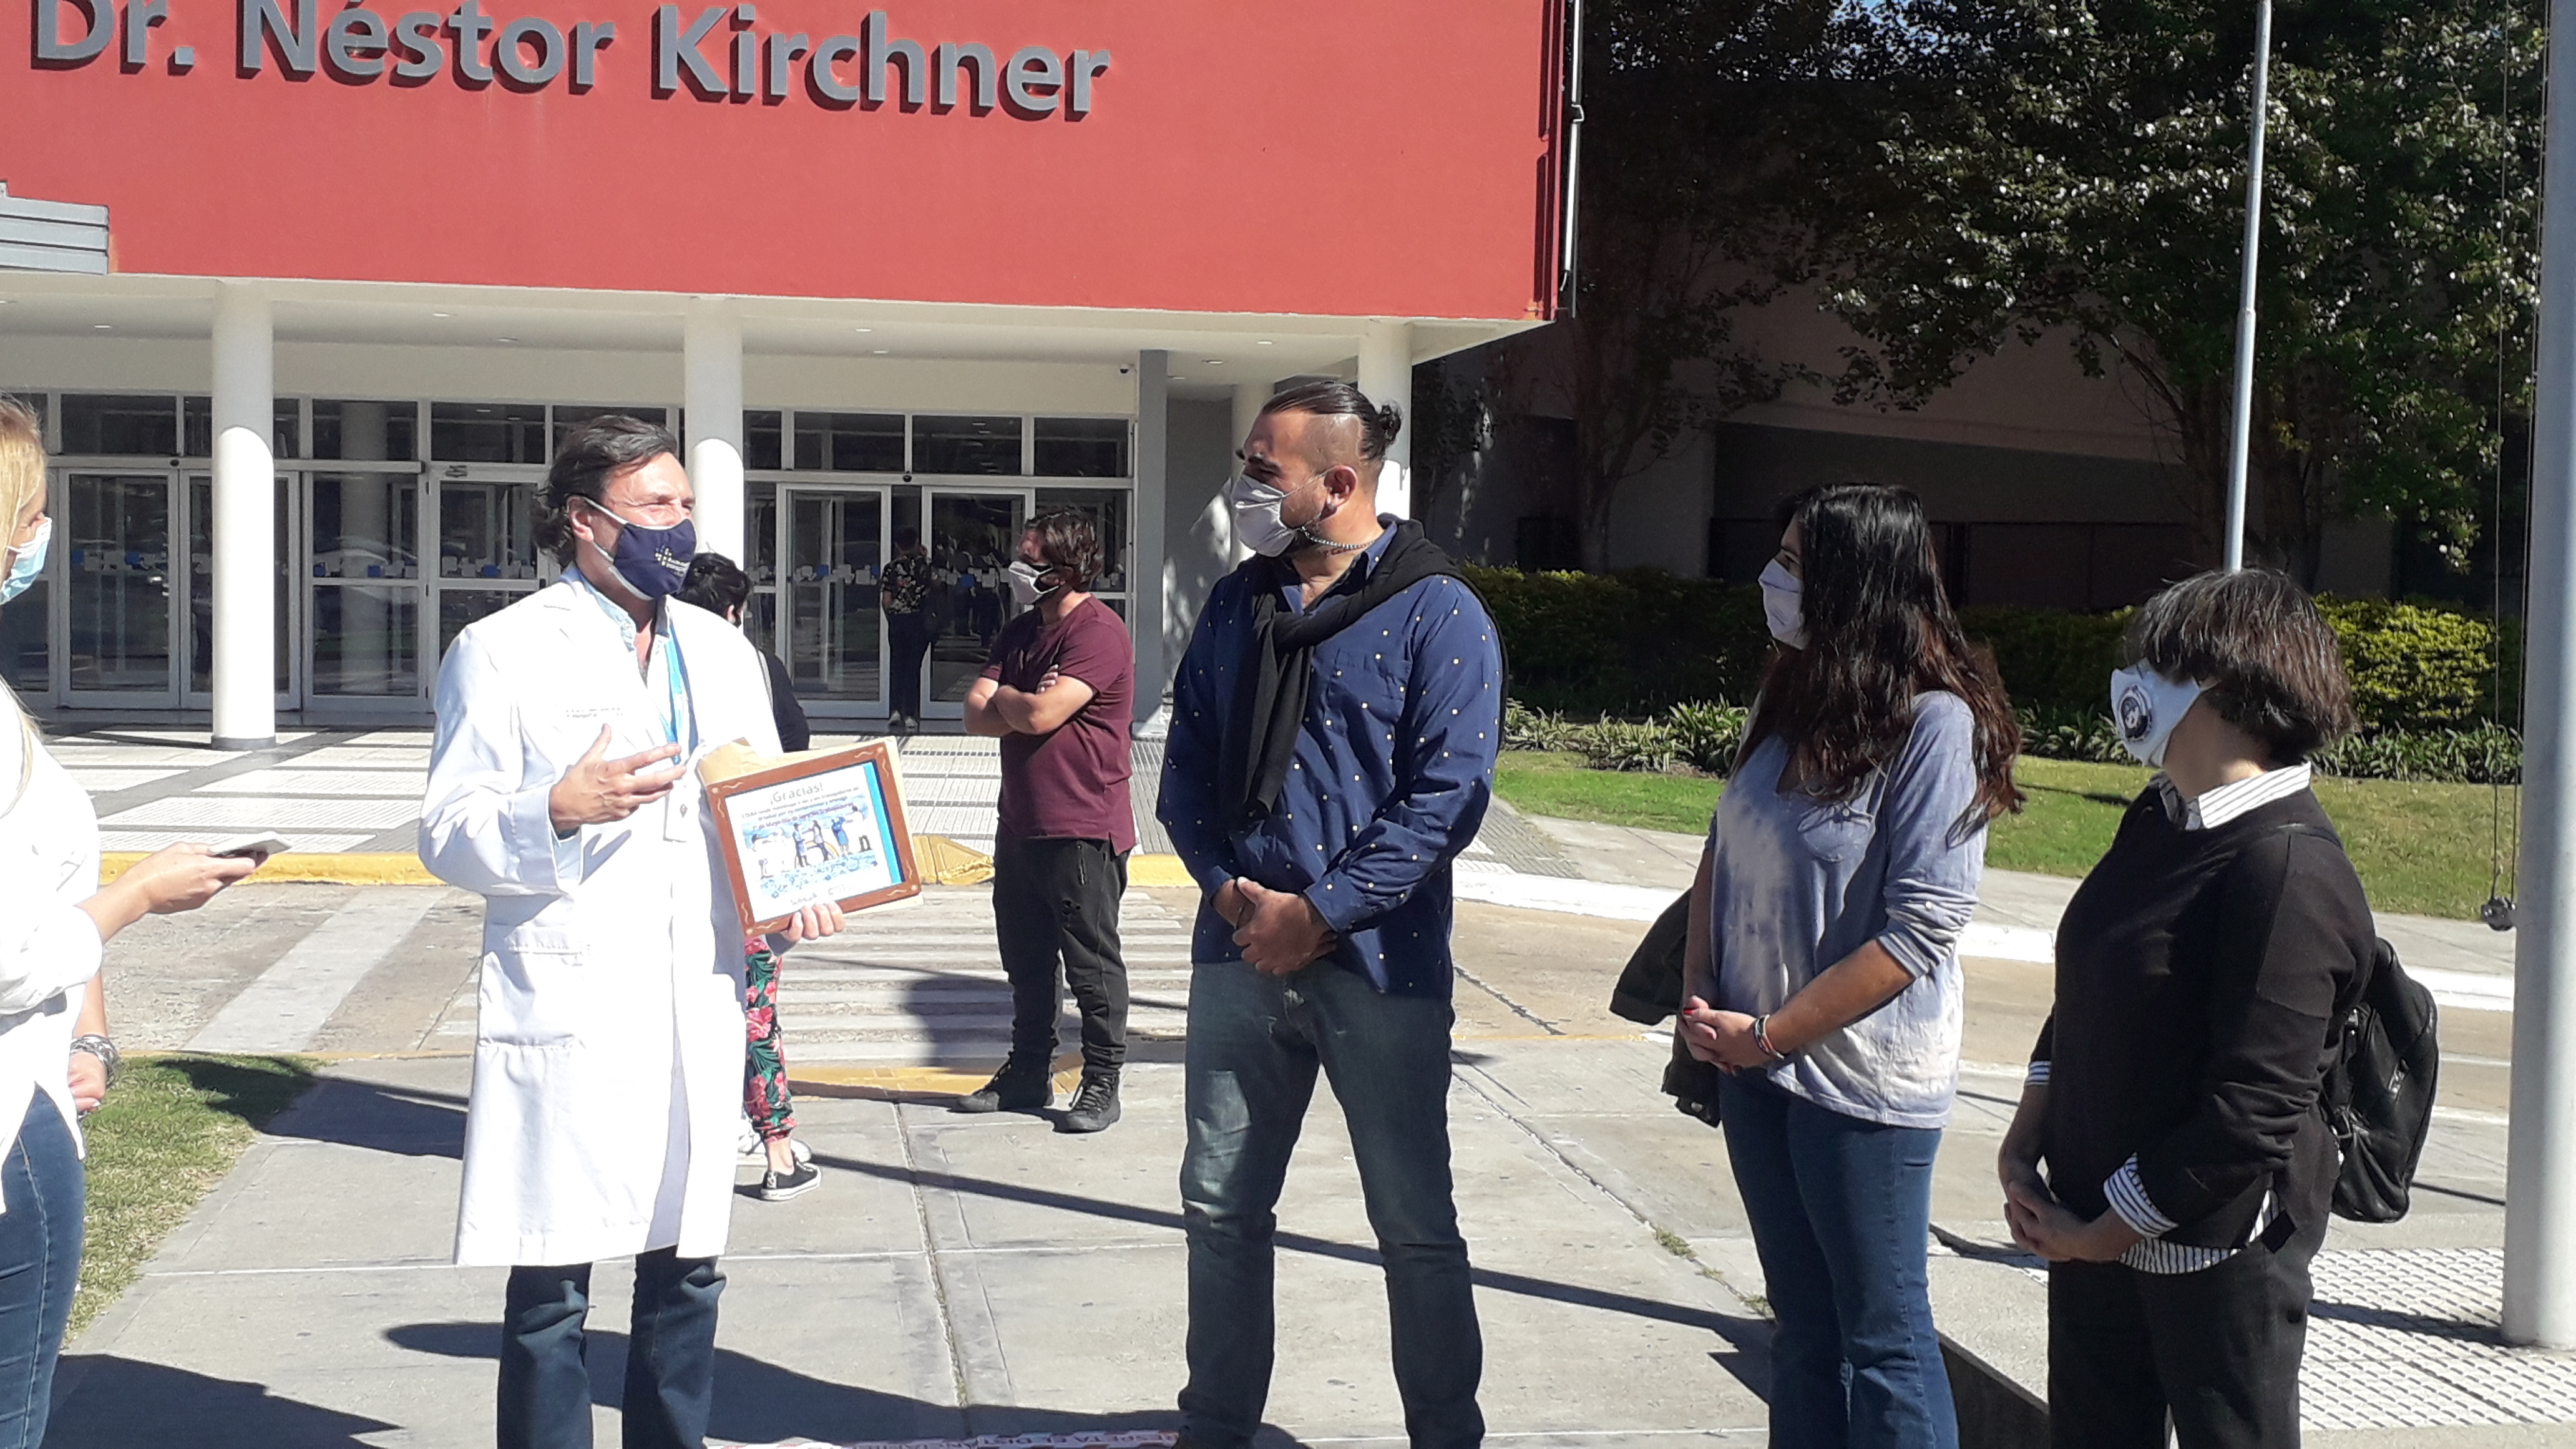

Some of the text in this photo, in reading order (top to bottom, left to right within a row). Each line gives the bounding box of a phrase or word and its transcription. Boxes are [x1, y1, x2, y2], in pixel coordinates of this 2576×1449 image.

[34, 0, 1110, 116] Dr. Néstor Kirchner
[770, 782, 823, 805] ¡Gracias!
